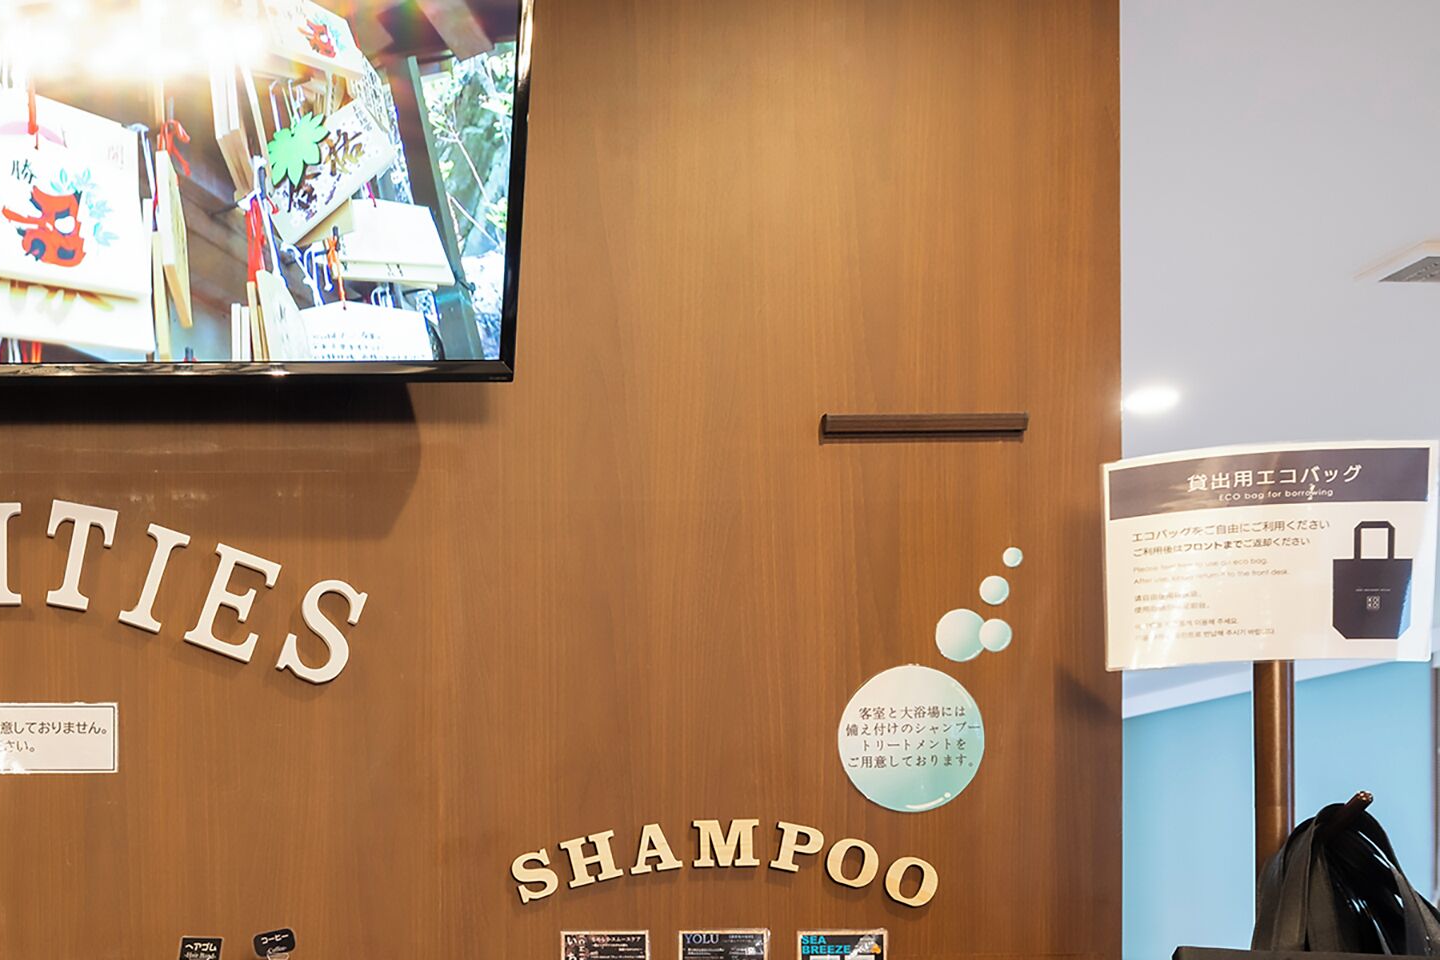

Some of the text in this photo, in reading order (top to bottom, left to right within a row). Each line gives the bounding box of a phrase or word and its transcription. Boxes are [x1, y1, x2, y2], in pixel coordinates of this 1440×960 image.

[1187, 464, 1362, 492] 貸出用エコバッグ
[1219, 493, 1241, 501] ECO
[1244, 492, 1265, 500] bag
[1268, 490, 1281, 498] for
[1132, 520, 1331, 543] エコバッグをご自由にご利用ください
[859, 706, 966, 720] 客室と大浴場には
[846, 721, 980, 737] 備え付けのシャンプー
[862, 739, 966, 751] トリートメントを
[847, 754, 974, 768] ご用意しております。
[510, 817, 940, 908] SHAMPOO
[685, 934, 719, 944] YOLU
[801, 935, 827, 945] SEA
[801, 945, 851, 955] BREEZE
